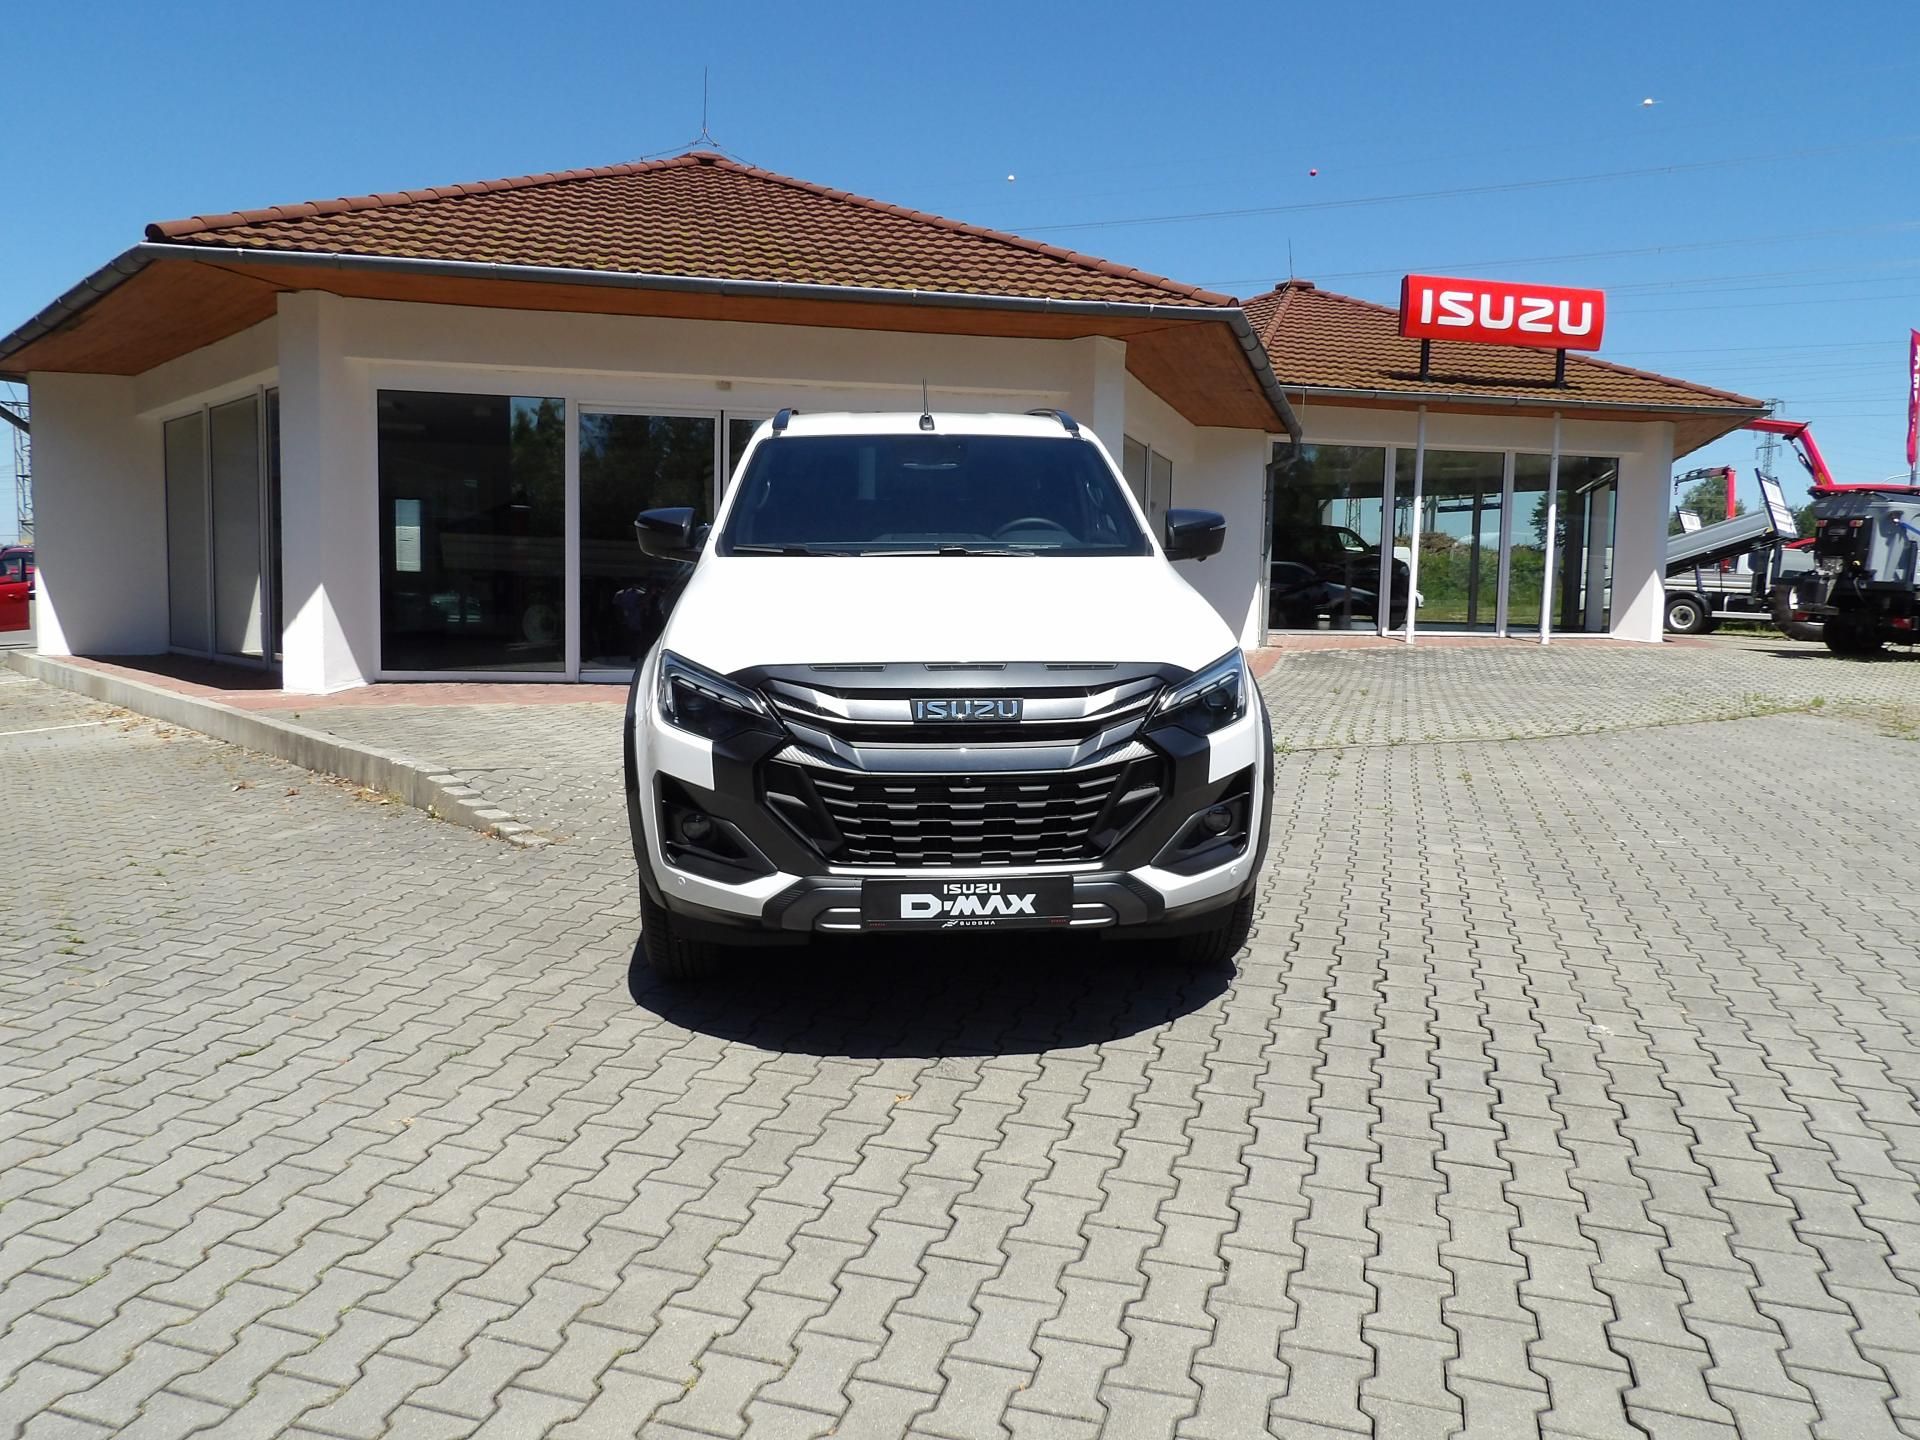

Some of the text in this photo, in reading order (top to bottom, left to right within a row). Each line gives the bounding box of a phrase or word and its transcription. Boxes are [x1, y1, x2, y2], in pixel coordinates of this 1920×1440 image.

[1421, 289, 1592, 336] ISUZU
[916, 701, 1018, 720] ISUZU
[943, 883, 1001, 894] ISUZU
[901, 893, 1037, 919] D-MAX
